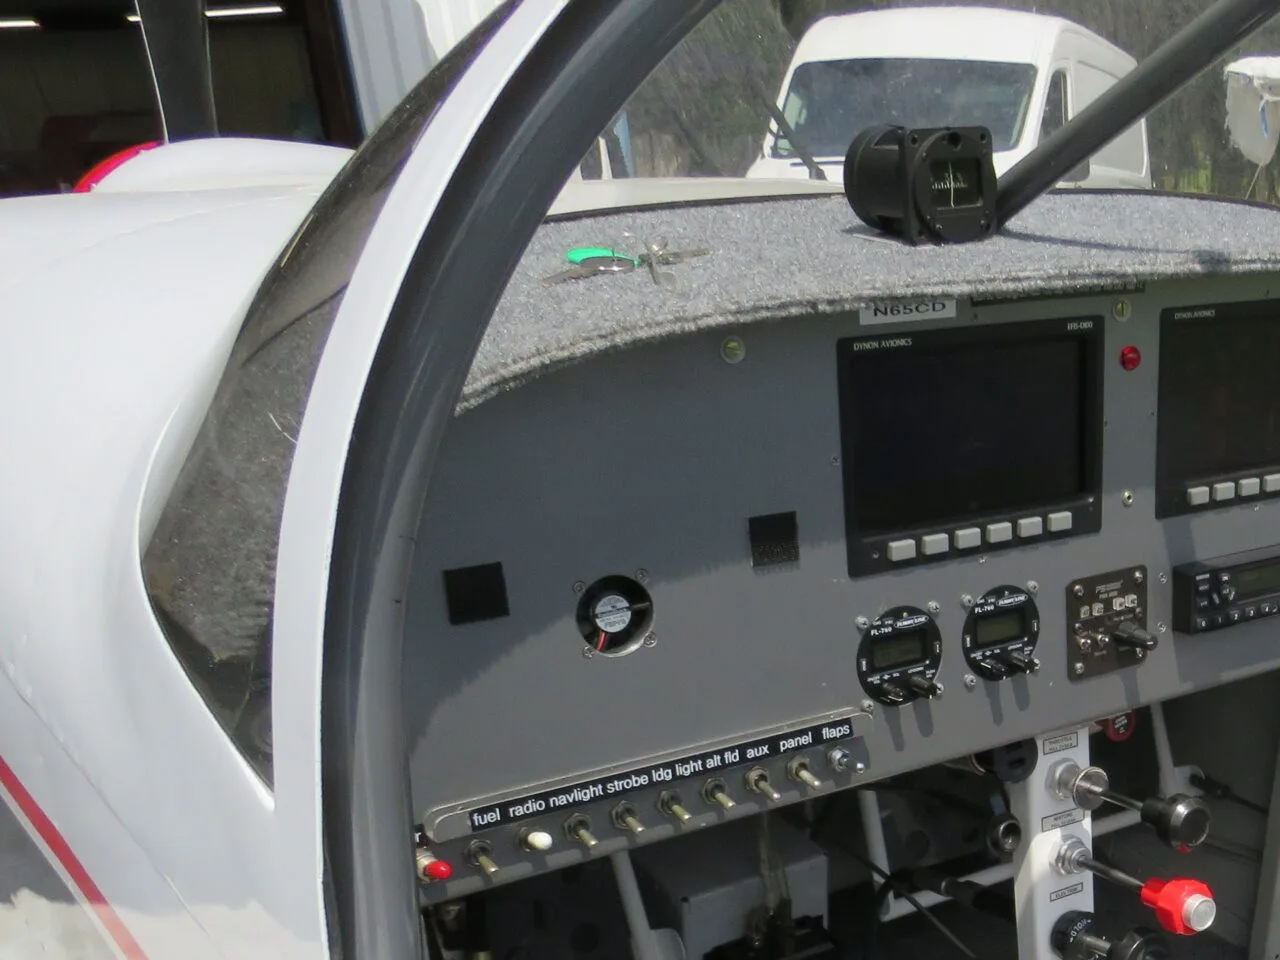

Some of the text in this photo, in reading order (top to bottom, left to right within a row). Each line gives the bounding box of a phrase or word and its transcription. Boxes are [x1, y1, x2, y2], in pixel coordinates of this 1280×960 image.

[873, 301, 946, 317] N65CD
[853, 337, 912, 352] DYNON AVIONICS
[473, 721, 851, 827] fuel radio navlight strobe ldg light alt fld aux panel flaps
